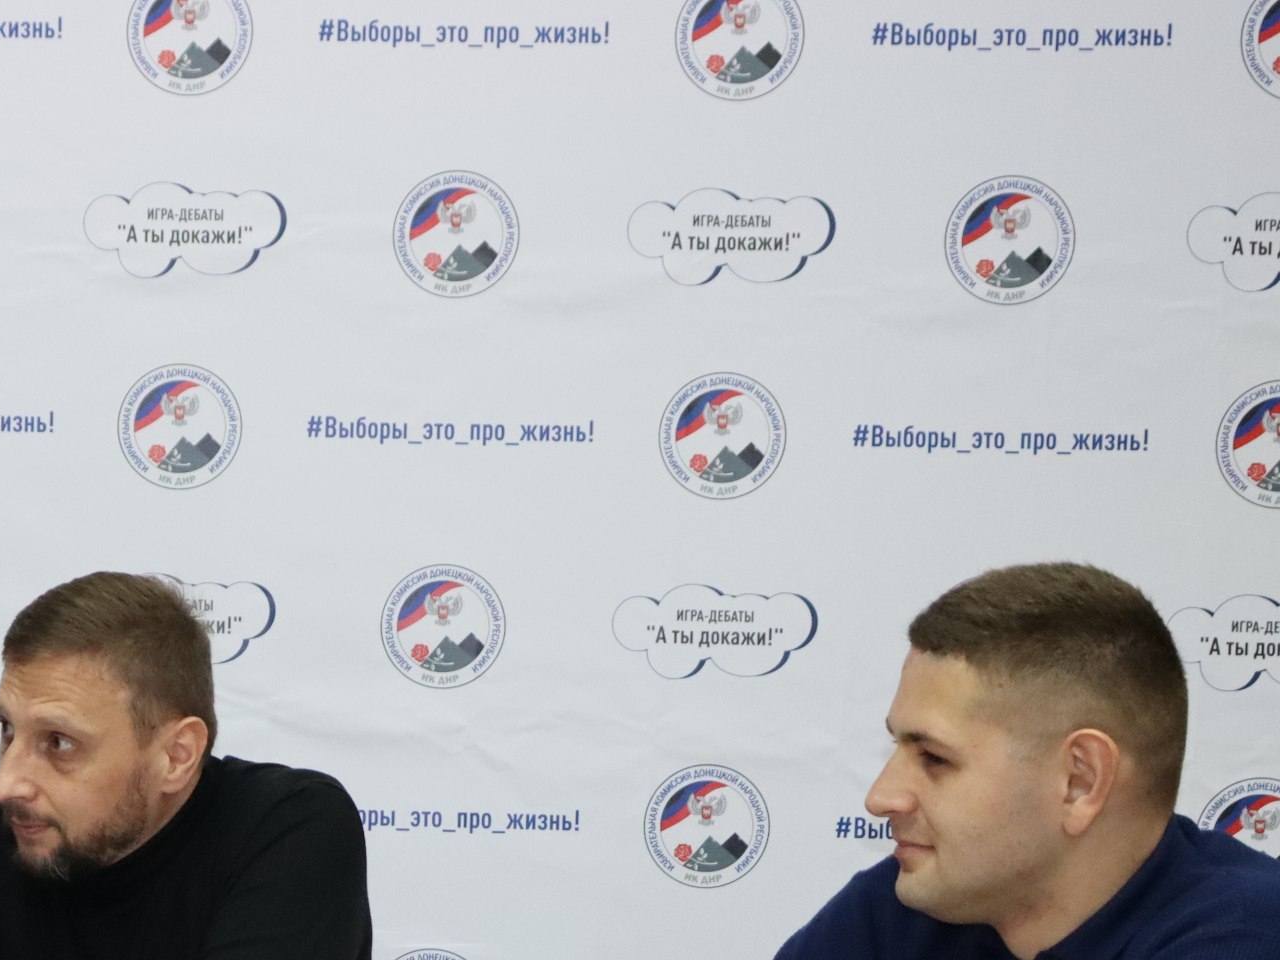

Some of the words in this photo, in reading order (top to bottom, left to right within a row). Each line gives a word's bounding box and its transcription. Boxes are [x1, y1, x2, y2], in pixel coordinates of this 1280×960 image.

[132, 12, 159, 79] ИЗБИРАТЕЛЬНАЯ
[319, 19, 609, 48] #Выборы_это_про_жизнь!
[680, 16, 707, 84] ИЗБИРАТЕЛЬНАЯ
[872, 22, 1172, 52] #Выборы_это_про_жизнь!
[218, 28, 248, 79] РЕСПУБЛИКИ
[768, 32, 799, 84] РЕСПУБЛИКИ
[1245, 17, 1274, 87] ИЗБИРАТЕЛЬНАЯ
[404, 179, 441, 214] КОМИССИЯ
[443, 175, 488, 191] ДОНЕЦКОЙ
[997, 180, 1044, 196] ДОНЕЦКОЙ
[147, 208, 223, 222] ИГРА-ДЕБАТЫ
[487, 188, 516, 230] НАРОДНОЙ
[956, 184, 995, 220] КОМИССИЯ
[1042, 193, 1071, 236] НАРОДНОЙ
[143, 229, 164, 243] ты
[169, 226, 252, 246] докажи!"
[693, 215, 771, 230] ИГРА-ДЕБАТЫ
[398, 215, 425, 282] ИЗБИРАТЕЛЬНАЯ
[484, 231, 514, 282] РЕСПУБЛИКИ
[688, 236, 709, 250] ты
[715, 233, 801, 254] докажи!"
[949, 221, 977, 289] ИЗБИРАТЕЛЬНАЯ
[1249, 241, 1272, 256] ты
[1038, 237, 1070, 288] РЕСПУБЛИКИ
[128, 372, 164, 406] КОМИССИЯ
[166, 368, 211, 384] ДОНЕЦКОЙ
[709, 377, 755, 392] ДОНЕЦКОЙ
[210, 381, 238, 423] НАРОДНОЙ
[670, 381, 707, 415] КОМИССИЯ
[754, 390, 783, 432] НАРОДНОЙ
[1228, 388, 1267, 423] КОМИССИЯ
[122, 407, 149, 473] ИЗБИРАТЕЛЬНАЯ
[307, 416, 594, 446] #Выборы_это_про_жизнь!
[853, 424, 1149, 455] #Выборы_это_про_жизнь!
[208, 424, 237, 474] РЕСПУБЛИКИ
[663, 416, 690, 483] ИЗБИРАТЕЛЬНАЯ
[750, 433, 781, 483] РЕСПУБЛИКИ
[1220, 424, 1248, 492] ИЗБИРАТЕЛЬНАЯ
[158, 474, 172, 484] ИК
[174, 475, 196, 486] ДНР
[700, 484, 713, 494] ИК
[716, 485, 738, 495] ДНР
[391, 572, 428, 606] КОМИССИЯ
[430, 568, 475, 584] ДОНЕЦКОЙ
[474, 581, 502, 623] НАРОДНОЙ
[677, 609, 754, 624] ИГРА-ДЕБАТЫ
[385, 607, 412, 672] ИЗБИРАТЕЛЬНАЯ
[672, 630, 693, 644] ты
[698, 628, 783, 648] докажи!"
[1231, 620, 1280, 635] ИГРА-ДЕ
[471, 624, 501, 673] РЕСПУБЛИКИ
[1226, 642, 1248, 656] ты
[421, 673, 435, 683] ИК
[437, 674, 459, 685] ДНР
[655, 772, 692, 806] КОМИССИЯ
[694, 769, 739, 784] ДОНЕЦКОЙ
[738, 782, 766, 823] НАРОДНОЙ
[1205, 786, 1245, 821] КОМИССИЯ
[358, 808, 581, 834] оры_это_про_жизнь!
[648, 807, 675, 872] ИЗБИРАТЕЛЬНАЯ
[734, 824, 765, 873] РЕСПУБЛИКИ
[684, 873, 698, 882] ИК
[700, 874, 722, 884] ДНР
